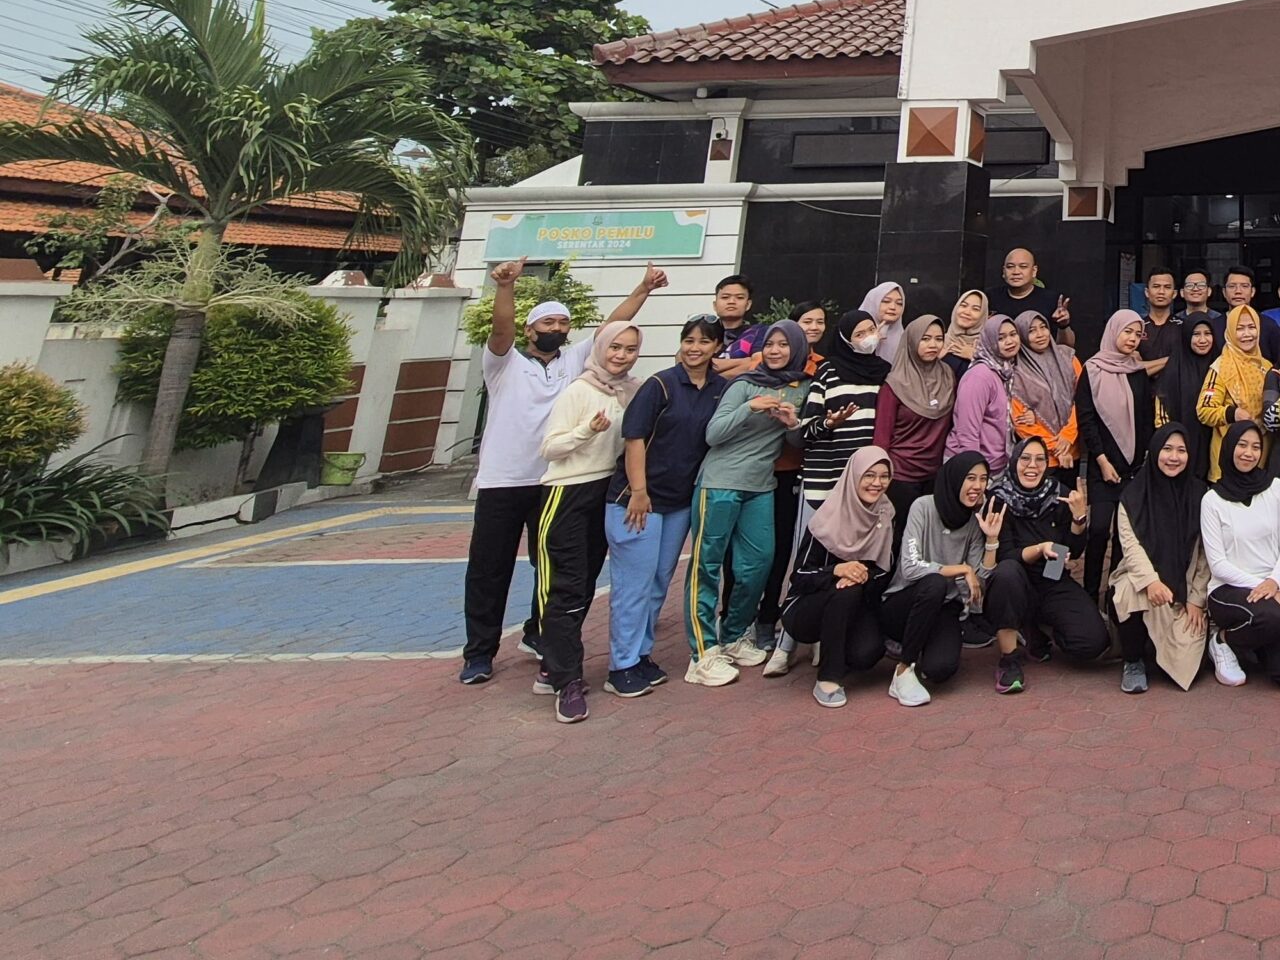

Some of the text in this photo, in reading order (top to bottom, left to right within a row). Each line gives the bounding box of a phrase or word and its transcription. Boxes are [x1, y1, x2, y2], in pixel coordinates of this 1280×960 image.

[537, 225, 656, 241] POSKO PEMILU
[557, 239, 632, 249] SERENTAK 2024
